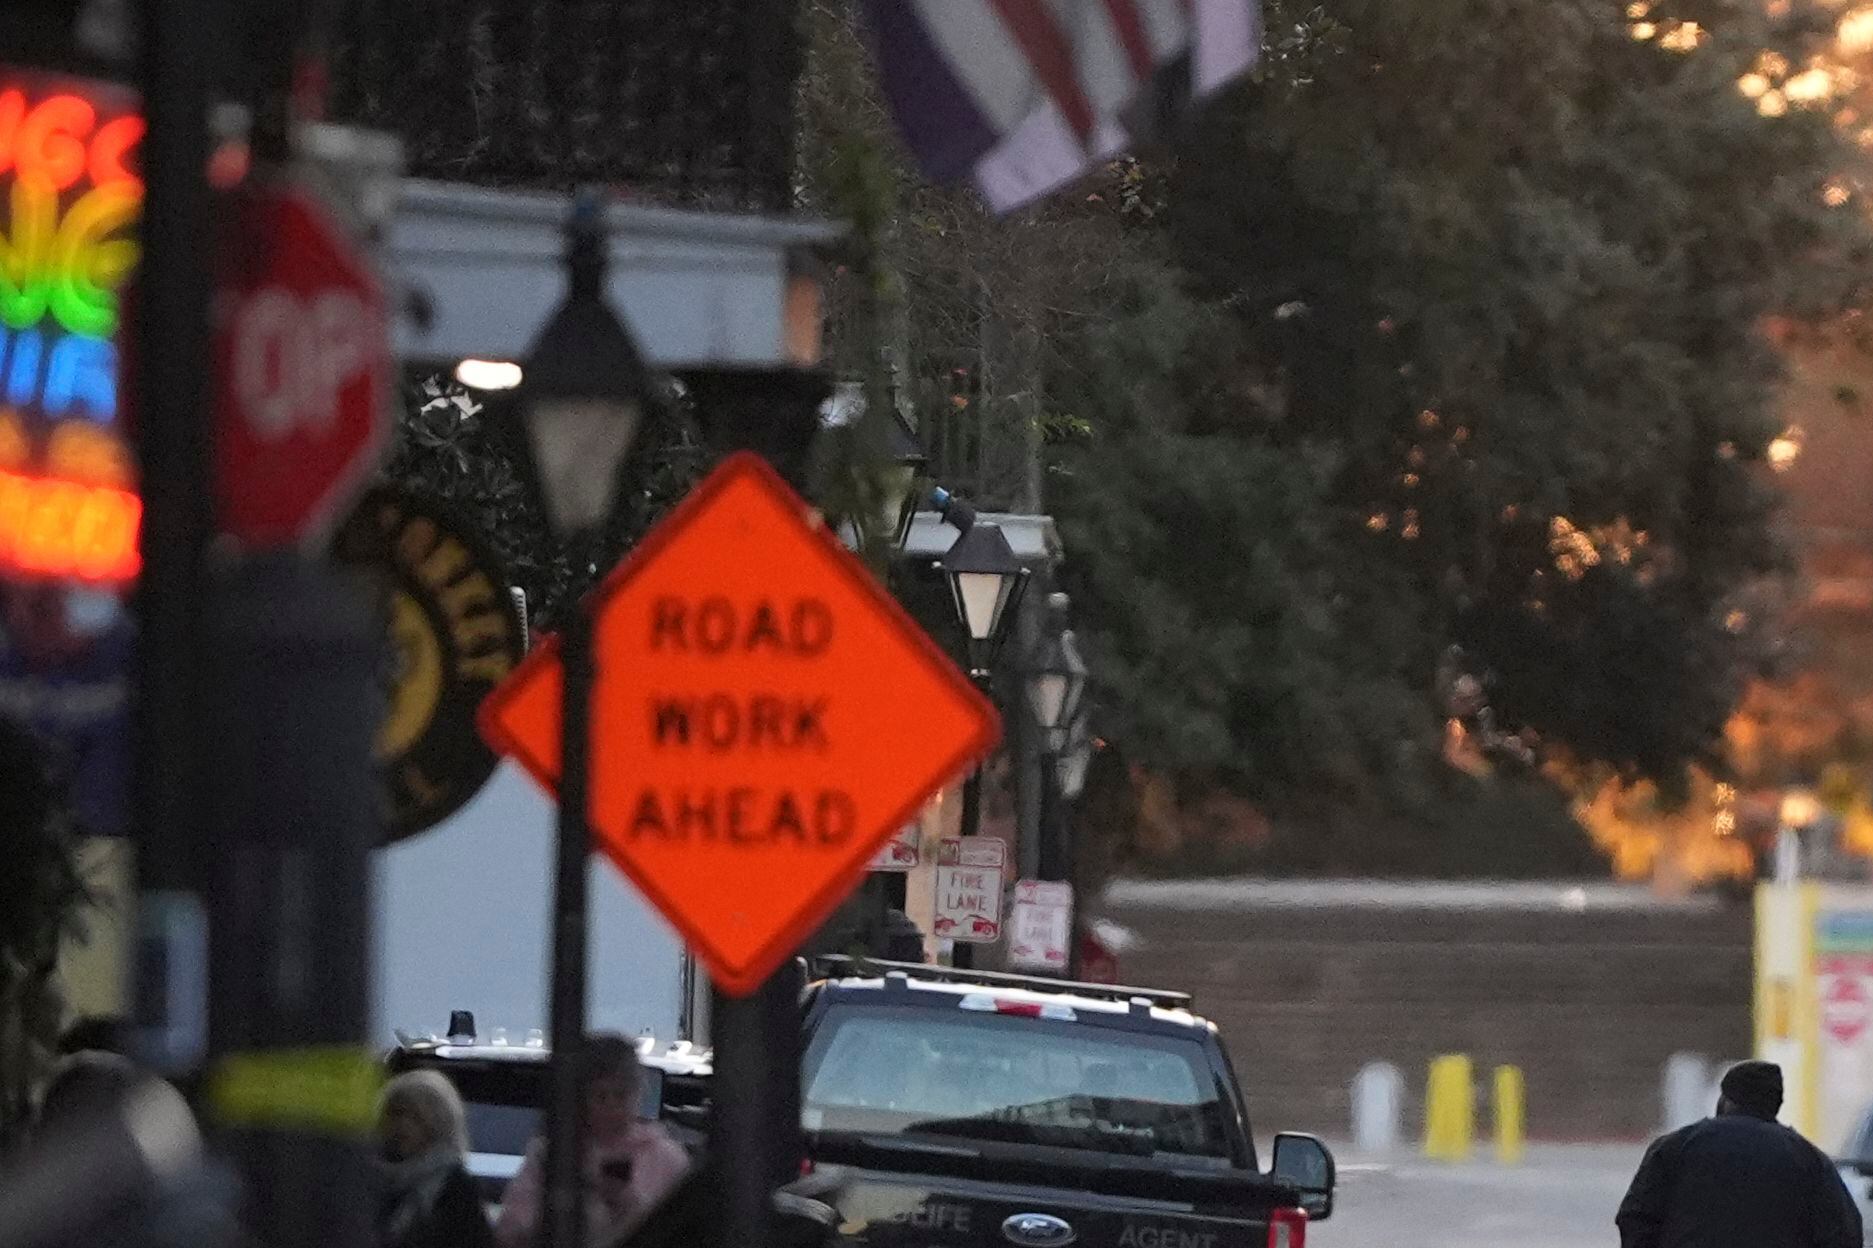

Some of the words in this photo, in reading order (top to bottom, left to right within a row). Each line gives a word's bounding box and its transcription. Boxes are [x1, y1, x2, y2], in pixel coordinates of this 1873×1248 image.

[652, 597, 834, 656] ROAD
[651, 694, 830, 753] WORK
[627, 787, 857, 844] AHEAD
[947, 894, 986, 912] LANE
[952, 872, 984, 890] FIRE
